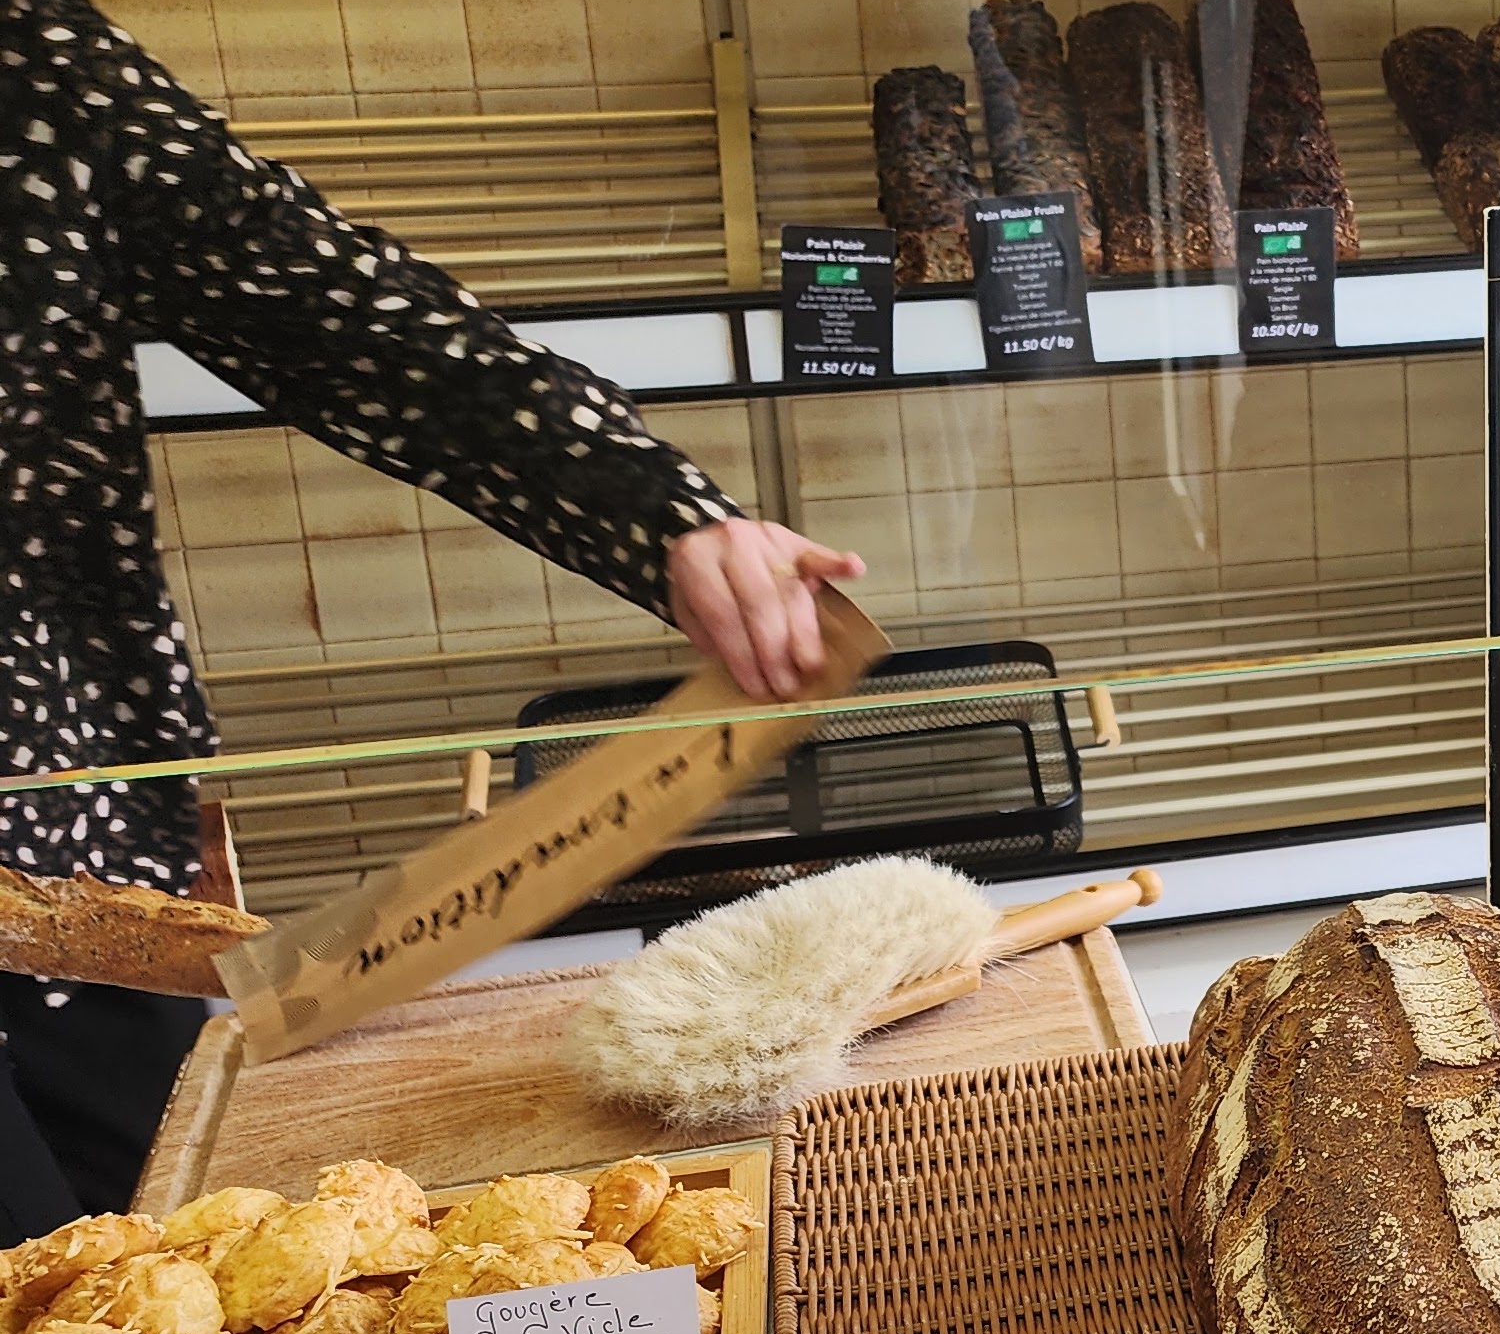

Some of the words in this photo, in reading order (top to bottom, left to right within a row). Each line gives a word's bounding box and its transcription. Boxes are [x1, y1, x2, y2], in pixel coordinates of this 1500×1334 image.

[975, 210, 1000, 222] Pain
[1000, 207, 1033, 220] Plaisir
[1034, 204, 1065, 216] Fruité
[1254, 223, 1277, 234] Pain
[1277, 221, 1309, 233] Plaisir
[806, 237, 831, 250] Pain
[832, 238, 866, 251] Plaisir
[1251, 324, 1286, 338] 10.50
[1003, 339, 1039, 354] 11.50
[801, 360, 840, 375] 11.50
